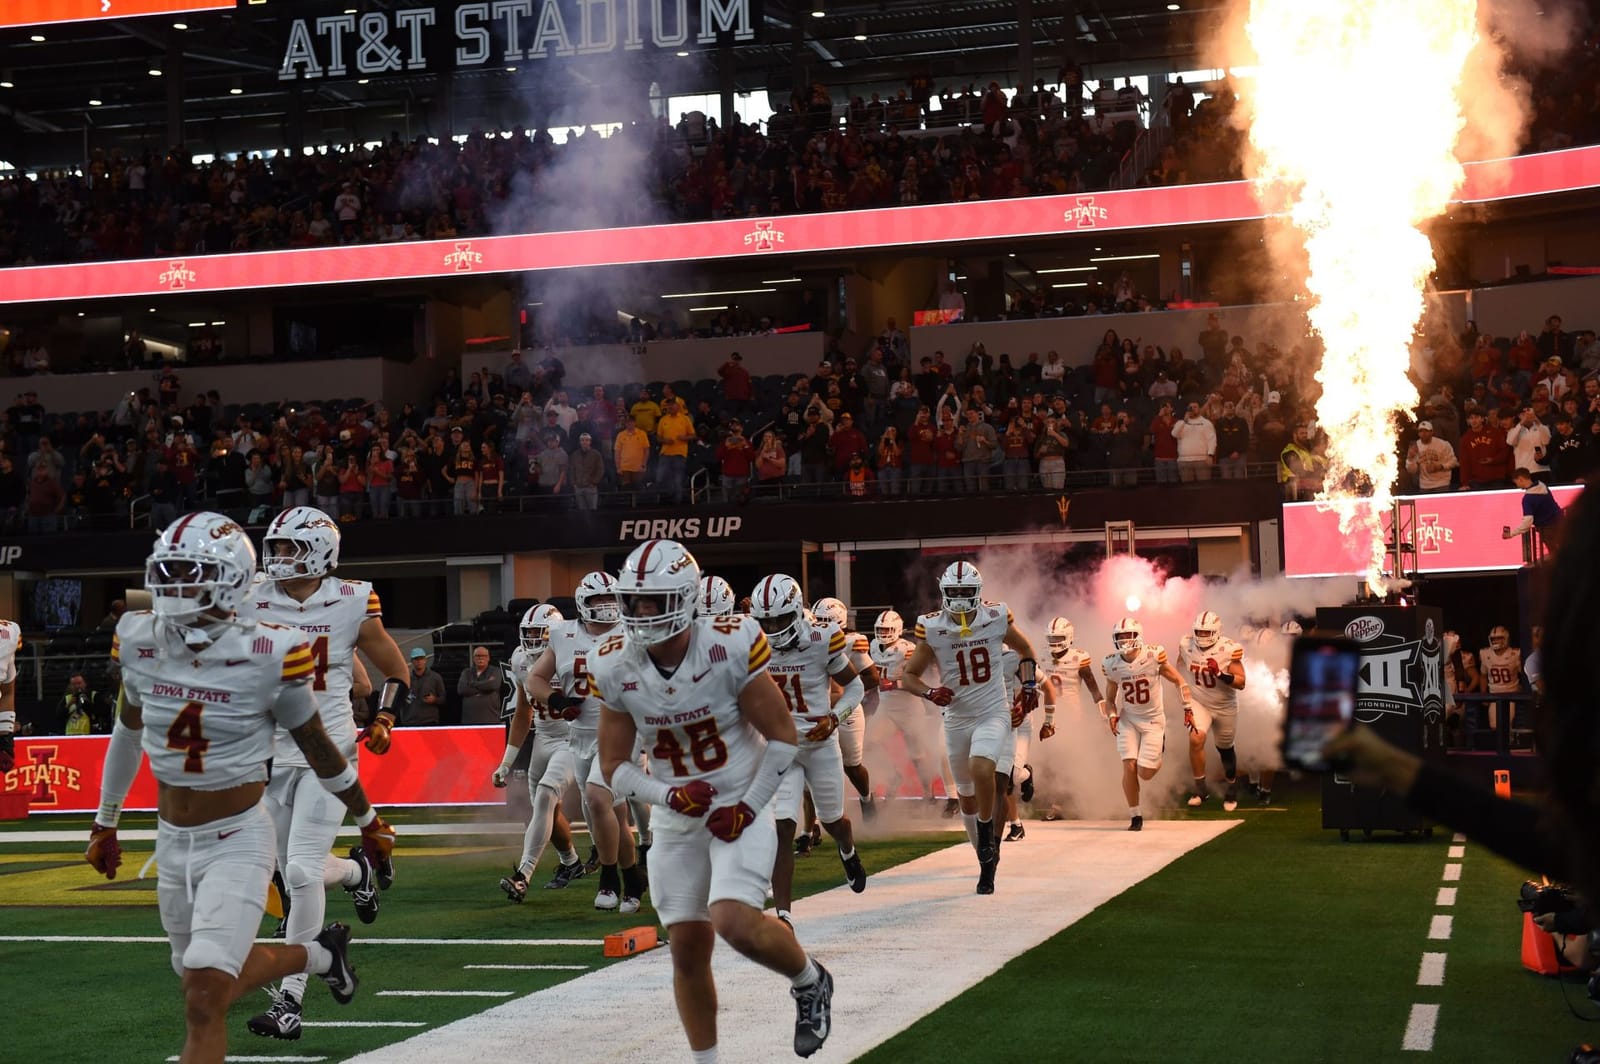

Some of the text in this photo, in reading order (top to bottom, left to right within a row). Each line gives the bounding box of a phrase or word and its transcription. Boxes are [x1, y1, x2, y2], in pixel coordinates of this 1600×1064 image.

[278, 0, 755, 81] AT&T STADIUM
[1063, 206, 1108, 222] STATE
[744, 230, 785, 245] STATE
[444, 251, 482, 266] STATE
[159, 269, 196, 284] STATE
[619, 516, 742, 540] FORKS UP
[1350, 622, 1380, 639] Pepper
[955, 646, 991, 686] 18
[1190, 664, 1217, 689] 70
[152, 684, 231, 703] IOWA STATE
[1121, 678, 1150, 705] 26
[644, 705, 711, 727] IOWA STATE
[166, 700, 211, 774] 4
[5, 763, 81, 792] STATE
